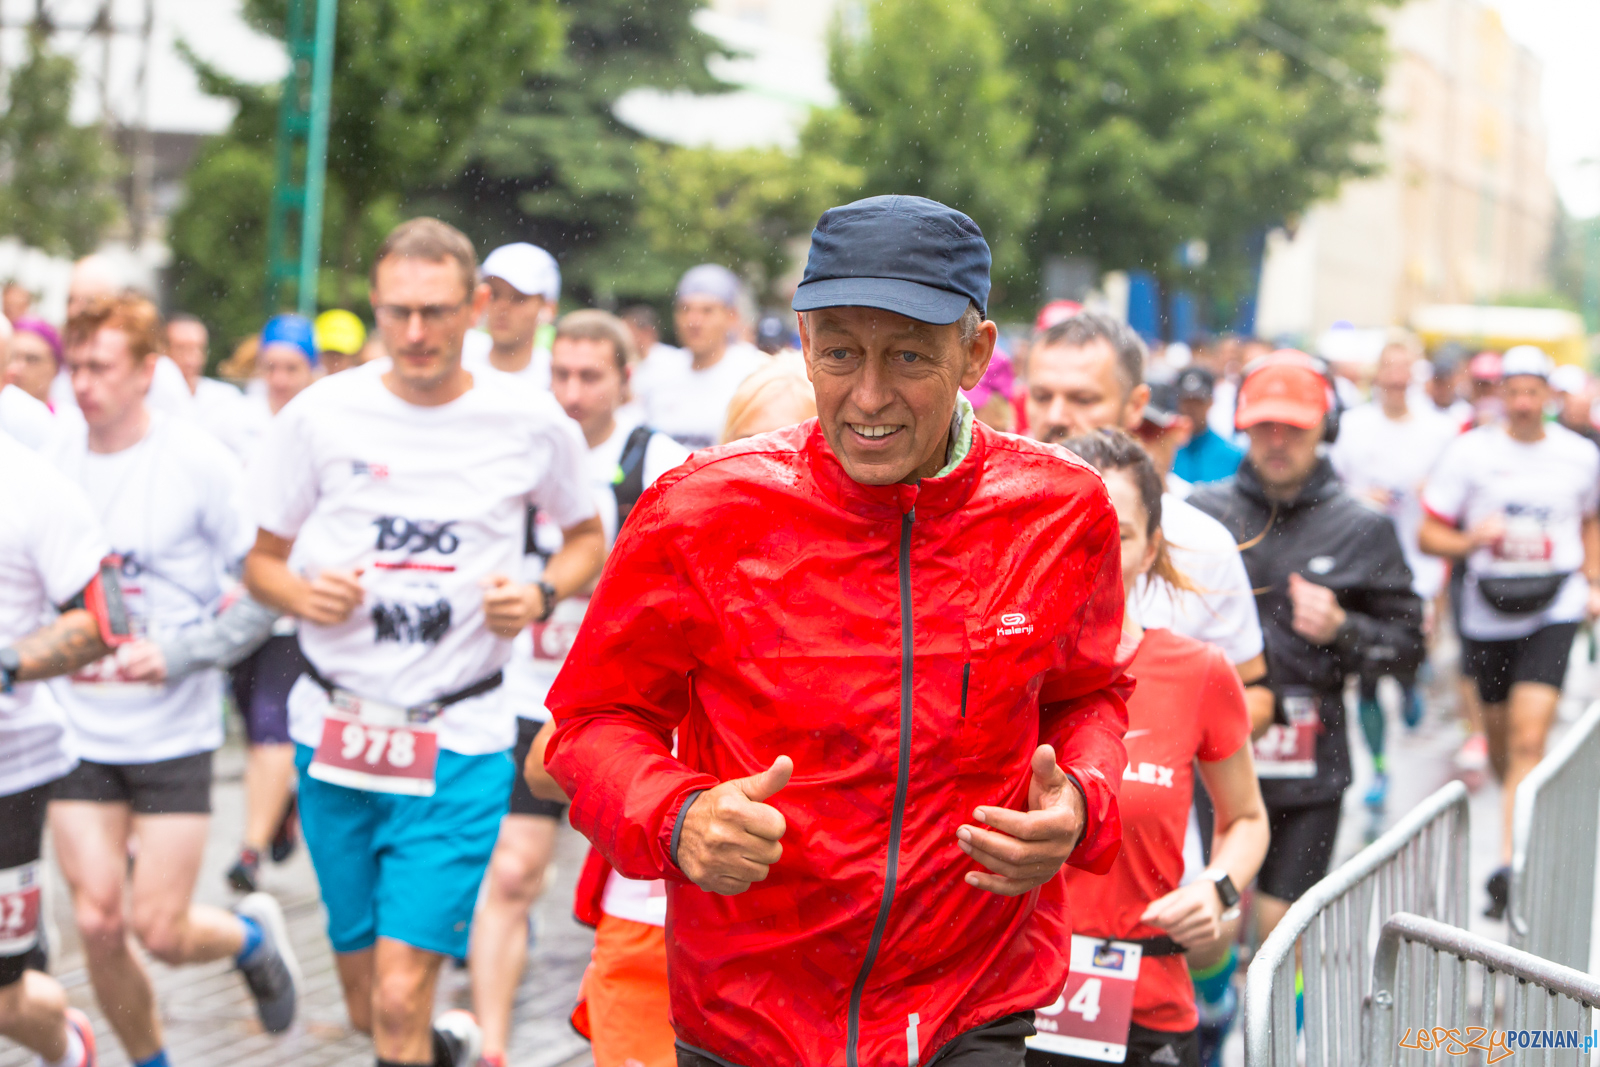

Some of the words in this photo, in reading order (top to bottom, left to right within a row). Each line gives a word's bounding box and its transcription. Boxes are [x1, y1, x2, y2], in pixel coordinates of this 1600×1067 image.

[372, 516, 459, 554] 1956
[996, 624, 1034, 636] Kalenji
[341, 723, 416, 768] 978
[0, 896, 26, 929] 2
